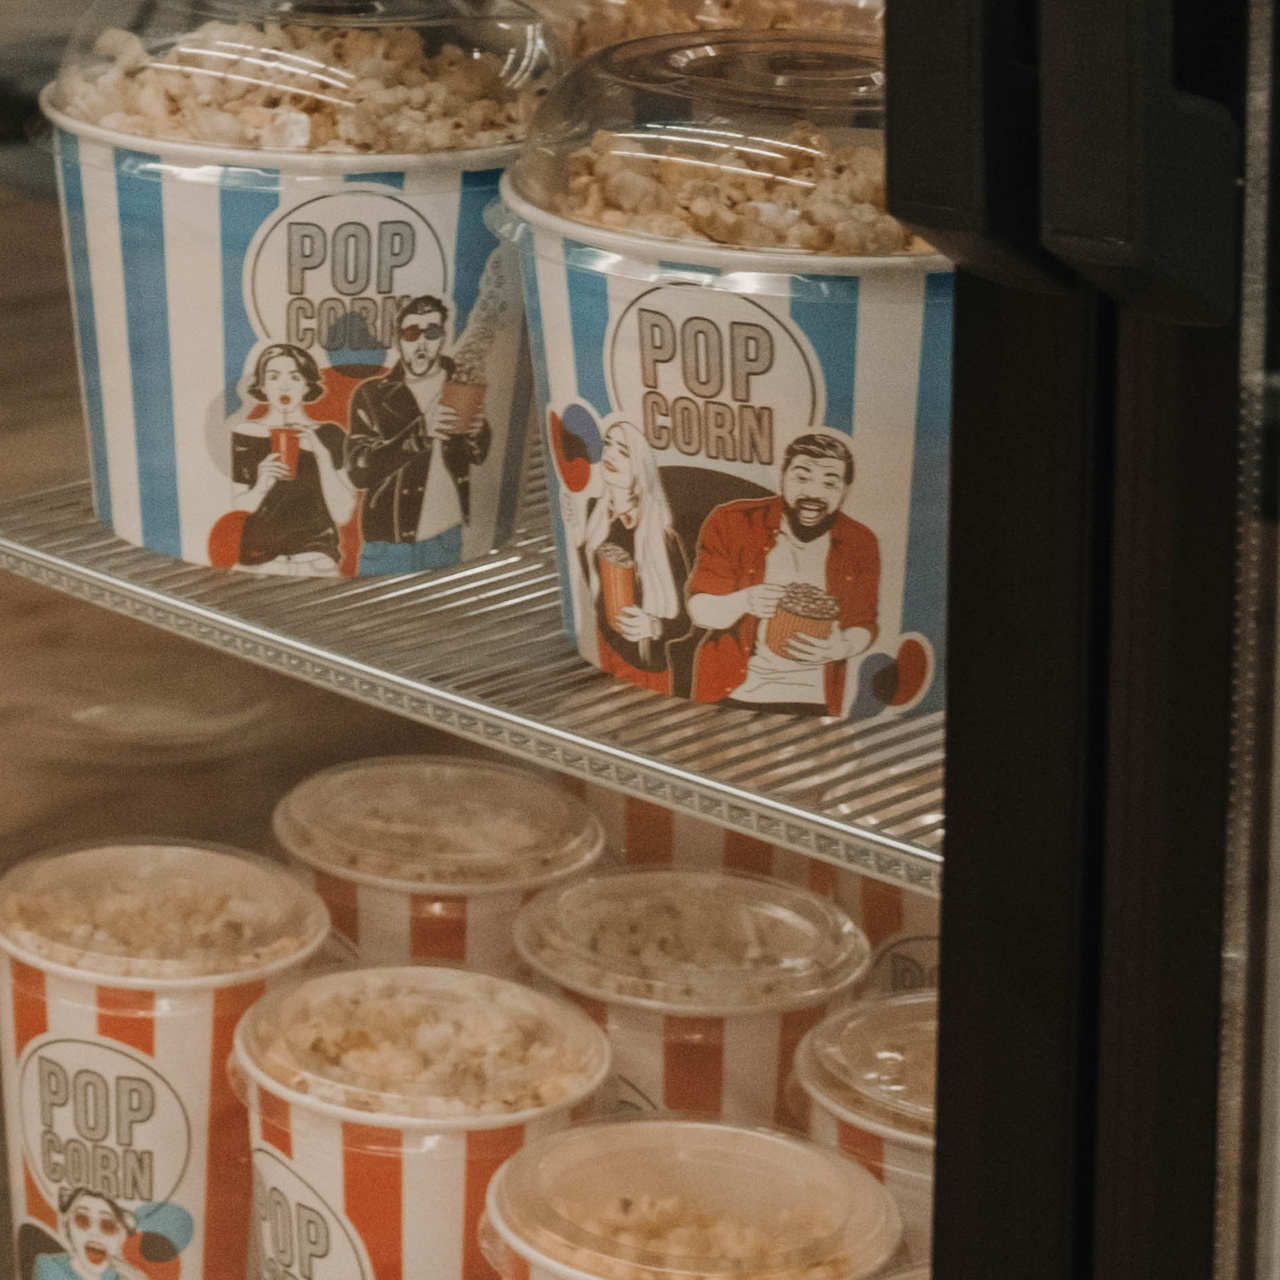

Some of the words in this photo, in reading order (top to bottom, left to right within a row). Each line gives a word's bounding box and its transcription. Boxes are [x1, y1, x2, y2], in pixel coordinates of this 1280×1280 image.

[287, 219, 417, 297] POP
[637, 306, 775, 403] POP
[641, 390, 774, 466] CORN
[37, 1054, 156, 1147] POP
[40, 1128, 154, 1201] CORN
